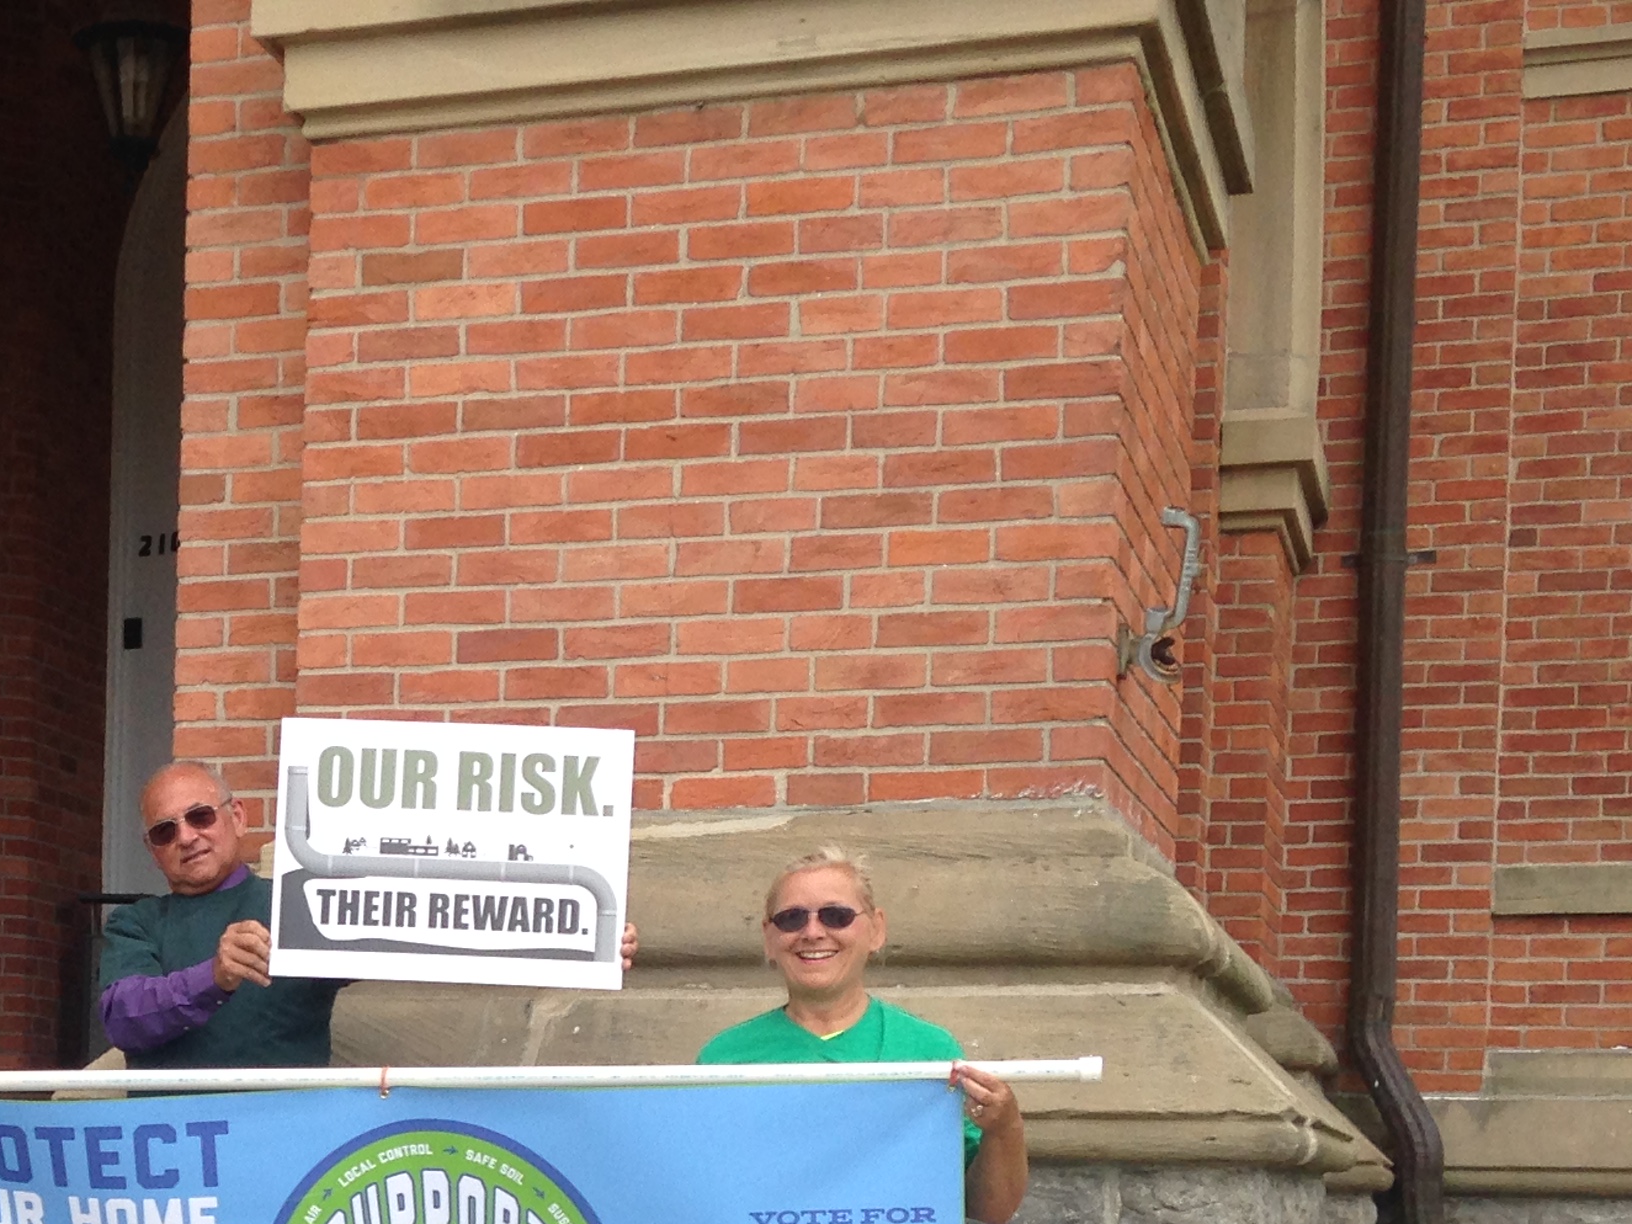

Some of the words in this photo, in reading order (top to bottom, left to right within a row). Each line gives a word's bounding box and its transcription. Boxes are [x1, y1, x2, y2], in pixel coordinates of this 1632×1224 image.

[317, 745, 438, 810] OUR
[456, 750, 614, 817] RISK.
[316, 889, 416, 929] THEIR
[428, 893, 588, 936] REWARD.
[338, 1159, 376, 1187] LOCAL
[377, 1144, 433, 1164] CONTROL
[465, 1149, 497, 1169] SAFE
[499, 1163, 525, 1186] SOIL
[860, 1207, 936, 1224] FOR
